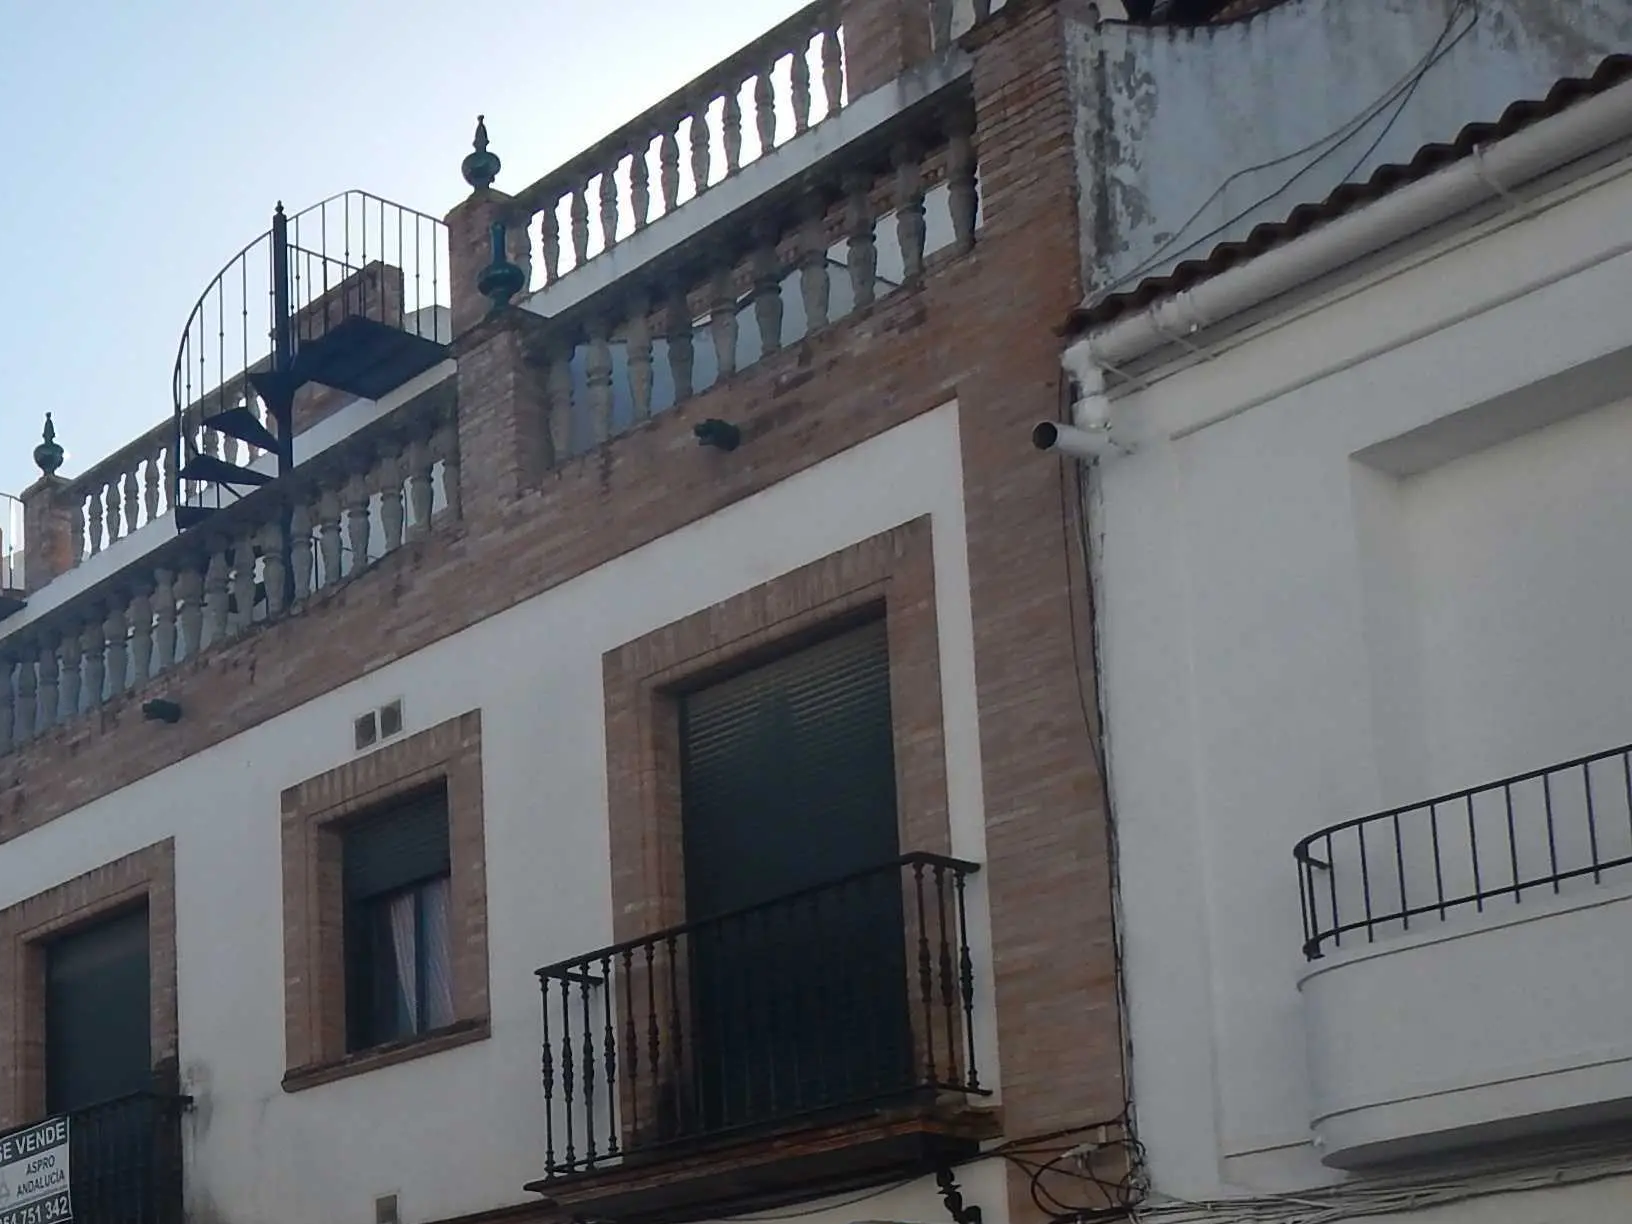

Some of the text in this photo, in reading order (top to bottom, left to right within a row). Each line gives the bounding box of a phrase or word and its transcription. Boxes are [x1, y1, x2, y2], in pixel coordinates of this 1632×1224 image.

[15, 1121, 66, 1156] VENDE
[26, 1154, 55, 1175] ASPRO
[45, 1196, 69, 1219] 342
